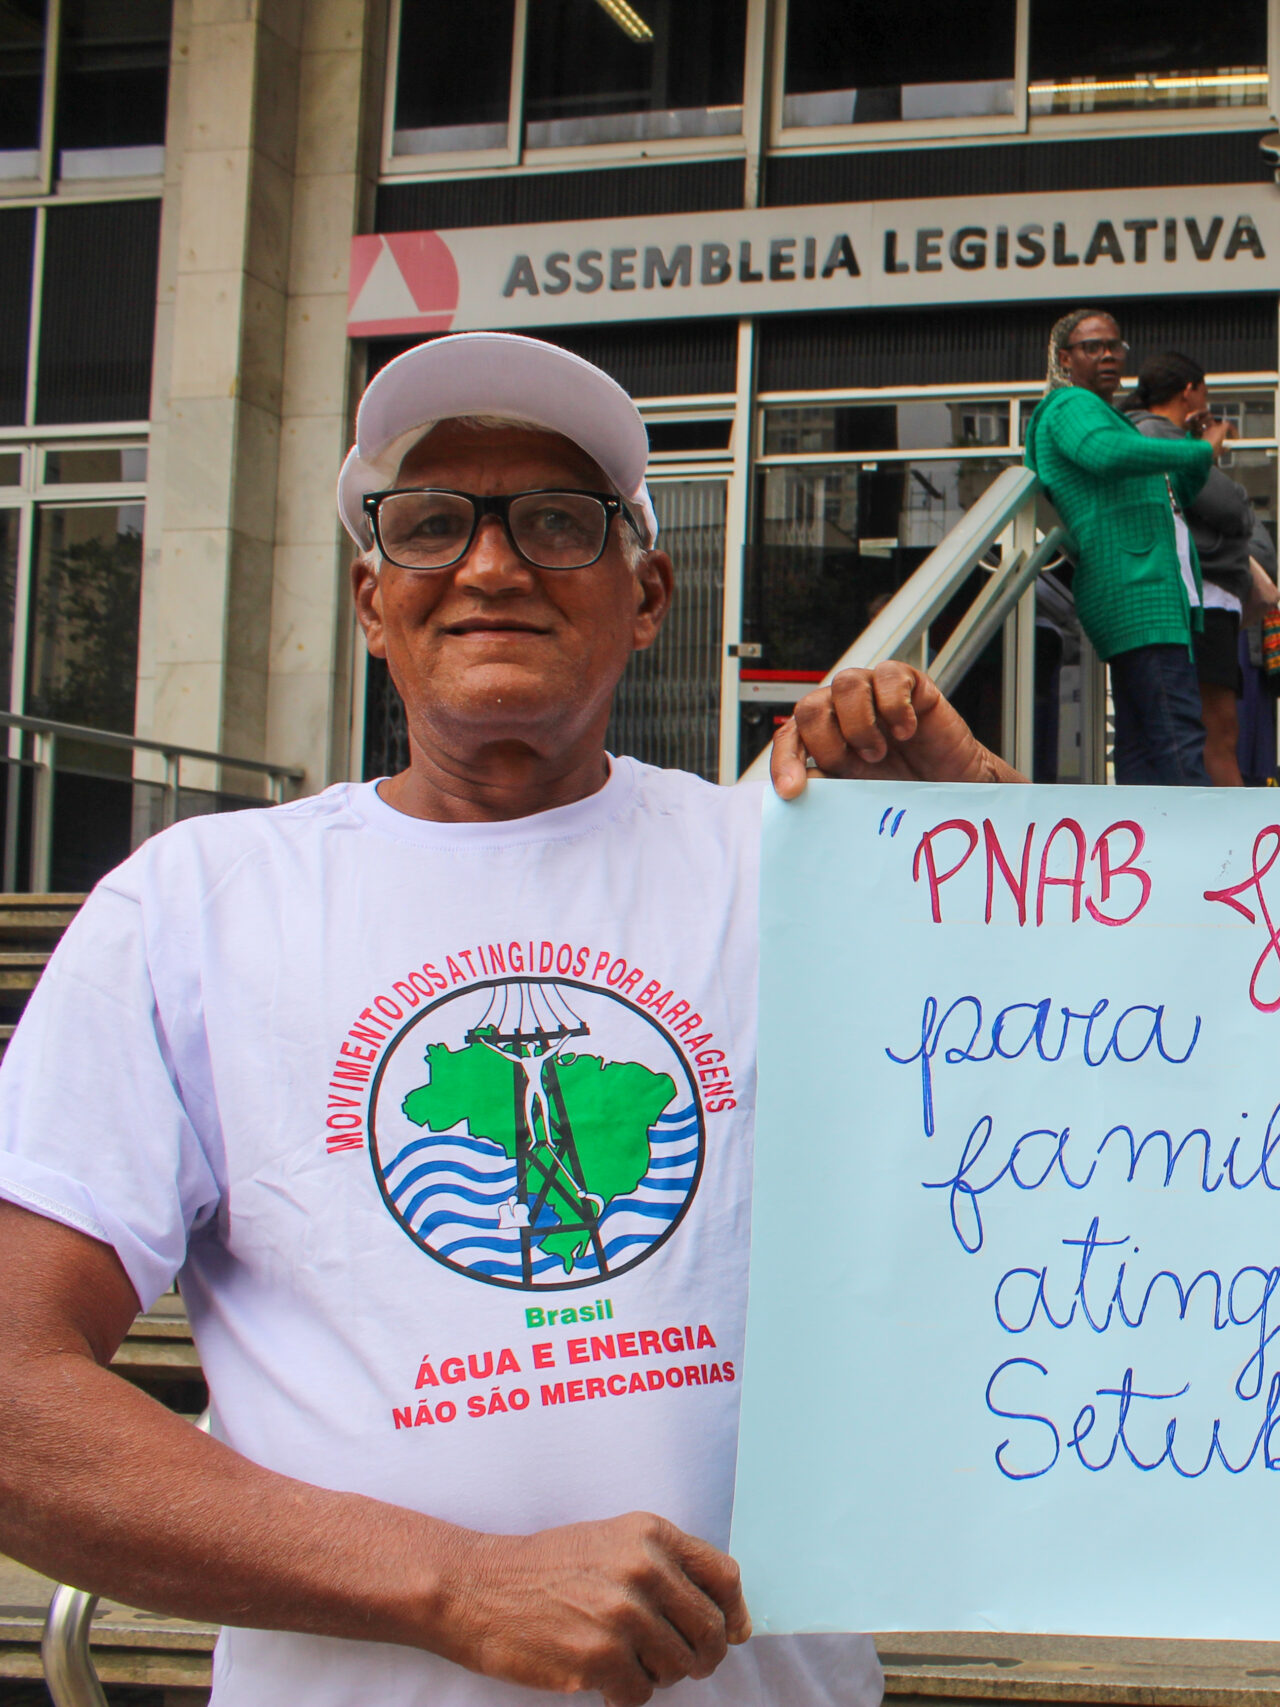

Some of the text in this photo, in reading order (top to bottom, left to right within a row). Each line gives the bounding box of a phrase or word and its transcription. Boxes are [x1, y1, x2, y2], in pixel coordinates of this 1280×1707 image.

[503, 233, 861, 297] ASSEMBLEIA
[883, 215, 1266, 274] LEGISLATIVA
[325, 940, 737, 1155] MOVIMENTO DOS ATINGIDOS POR BARRAGENS
[885, 995, 1202, 1137] para
[525, 1299, 613, 1329] Brasil
[415, 1324, 717, 1390] ÁGUA E ENERGIA
[393, 1361, 736, 1430] NÃO SÃO MERCADORIAS
